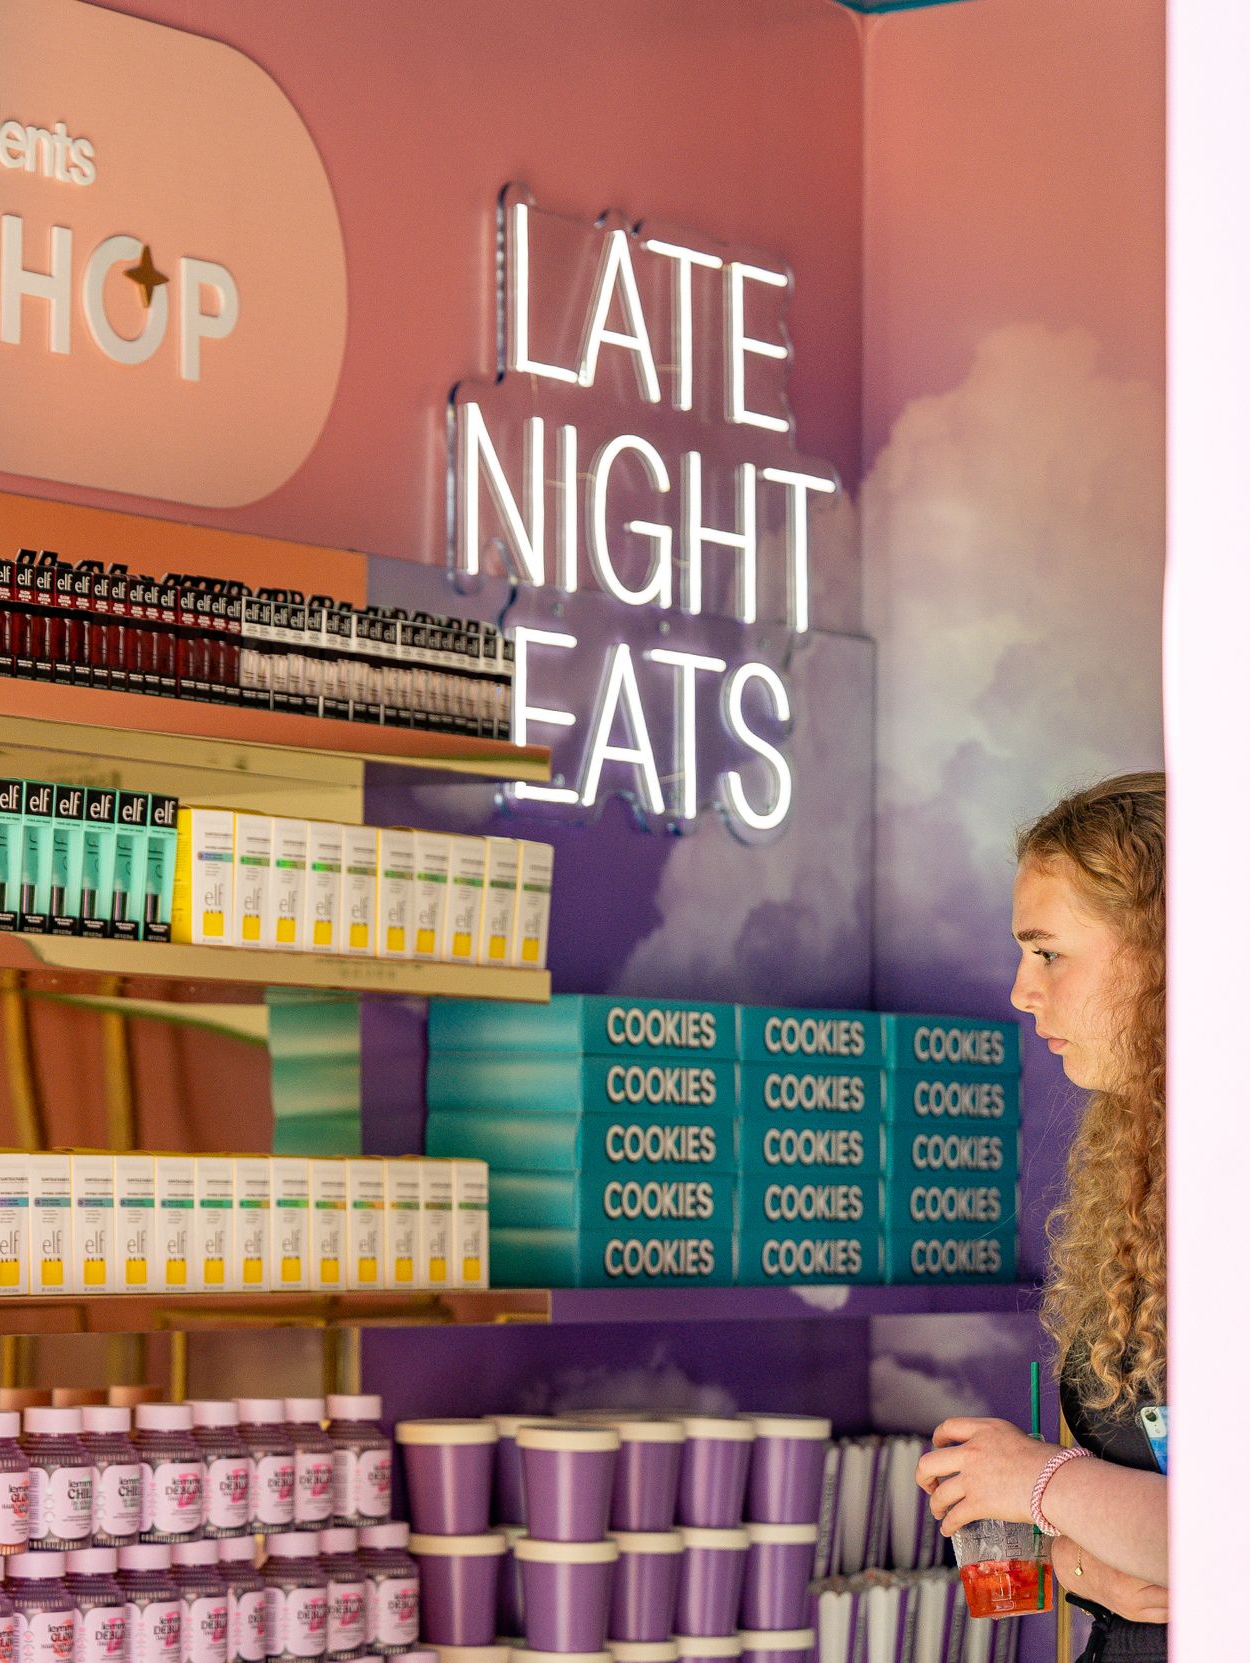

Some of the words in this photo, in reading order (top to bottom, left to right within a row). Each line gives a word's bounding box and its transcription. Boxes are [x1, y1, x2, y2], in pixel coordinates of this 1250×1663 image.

[511, 203, 789, 432] LATE
[461, 402, 837, 633] NIGHT
[18, 569, 33, 586] elf
[37, 572, 52, 589] elf
[513, 626, 793, 830] EATS
[0, 785, 20, 809] elf
[29, 788, 50, 813] elf
[60, 792, 81, 816] elf
[90, 795, 112, 819] elf
[122, 798, 144, 821] elf
[154, 801, 175, 824] elf
[204, 883, 224, 906] elf
[606, 1006, 717, 1048] COOKIES
[764, 1017, 865, 1056] COOKIES
[914, 1027, 1004, 1064] COOKIES
[606, 1066, 717, 1104] COOKIES
[764, 1074, 865, 1111] COOKIES
[914, 1082, 1004, 1118] COOKIES
[606, 1125, 716, 1163] COOKIES
[764, 1128, 864, 1165] COOKIES
[912, 1135, 1003, 1170] COOKIES
[604, 1181, 713, 1219] COOKIES
[765, 1185, 863, 1221] COOKIES
[911, 1187, 1001, 1221] COOKIES
[0, 1230, 19, 1254] elf
[604, 1239, 715, 1276] COOKIES
[762, 1239, 862, 1275] COOKIES
[911, 1239, 1002, 1275] COOKIES
